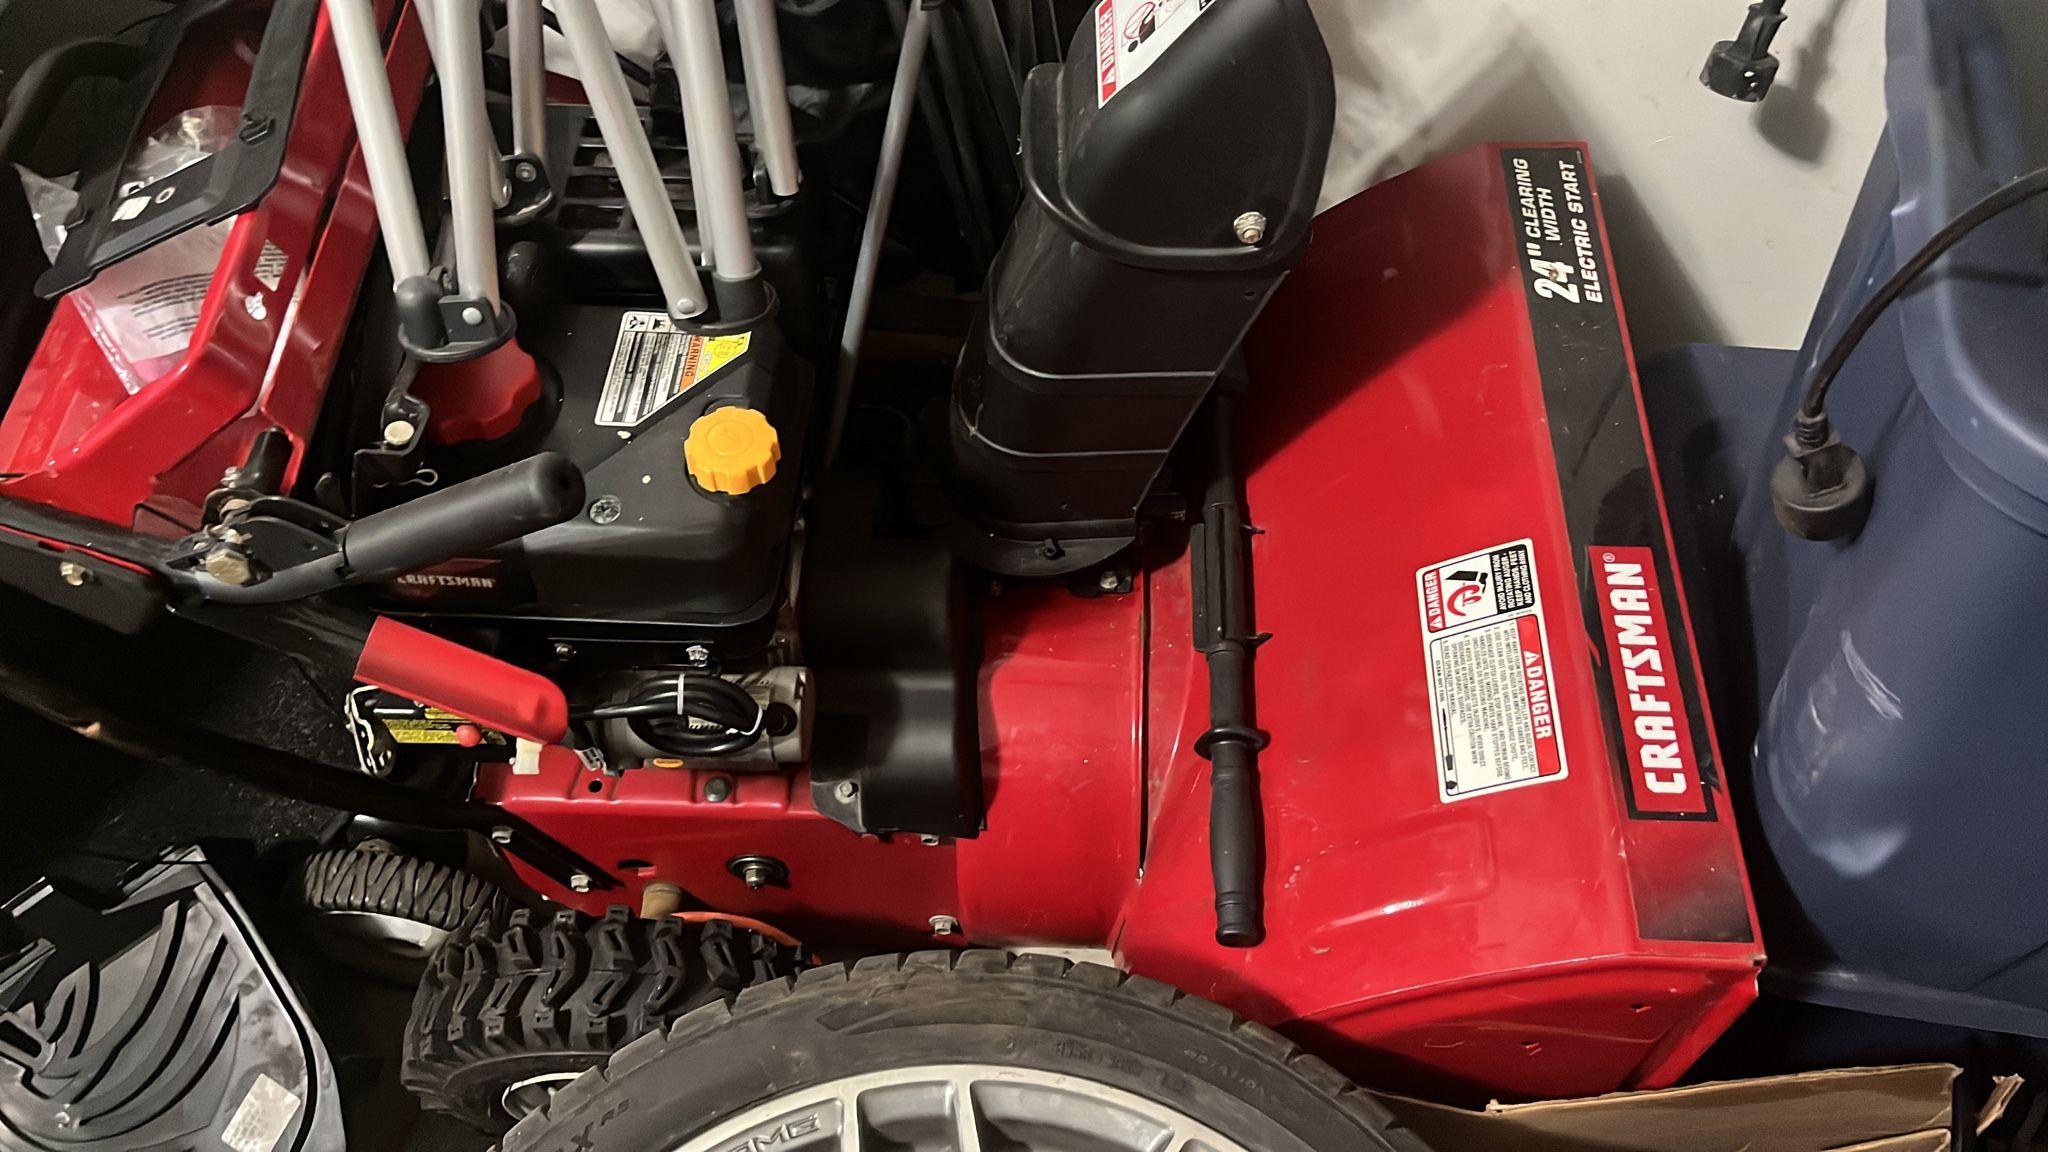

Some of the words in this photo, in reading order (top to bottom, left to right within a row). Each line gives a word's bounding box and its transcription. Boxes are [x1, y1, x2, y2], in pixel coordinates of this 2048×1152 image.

[1100, 8, 1115, 73] DANGER
[1513, 158, 1541, 238] CLEARING
[1536, 187, 1561, 241] WIDTH
[1559, 160, 1584, 213] START
[1571, 218, 1603, 303] ELECTRIC
[1424, 571, 1441, 615] DANGER
[1525, 666, 1553, 739] DANGER
